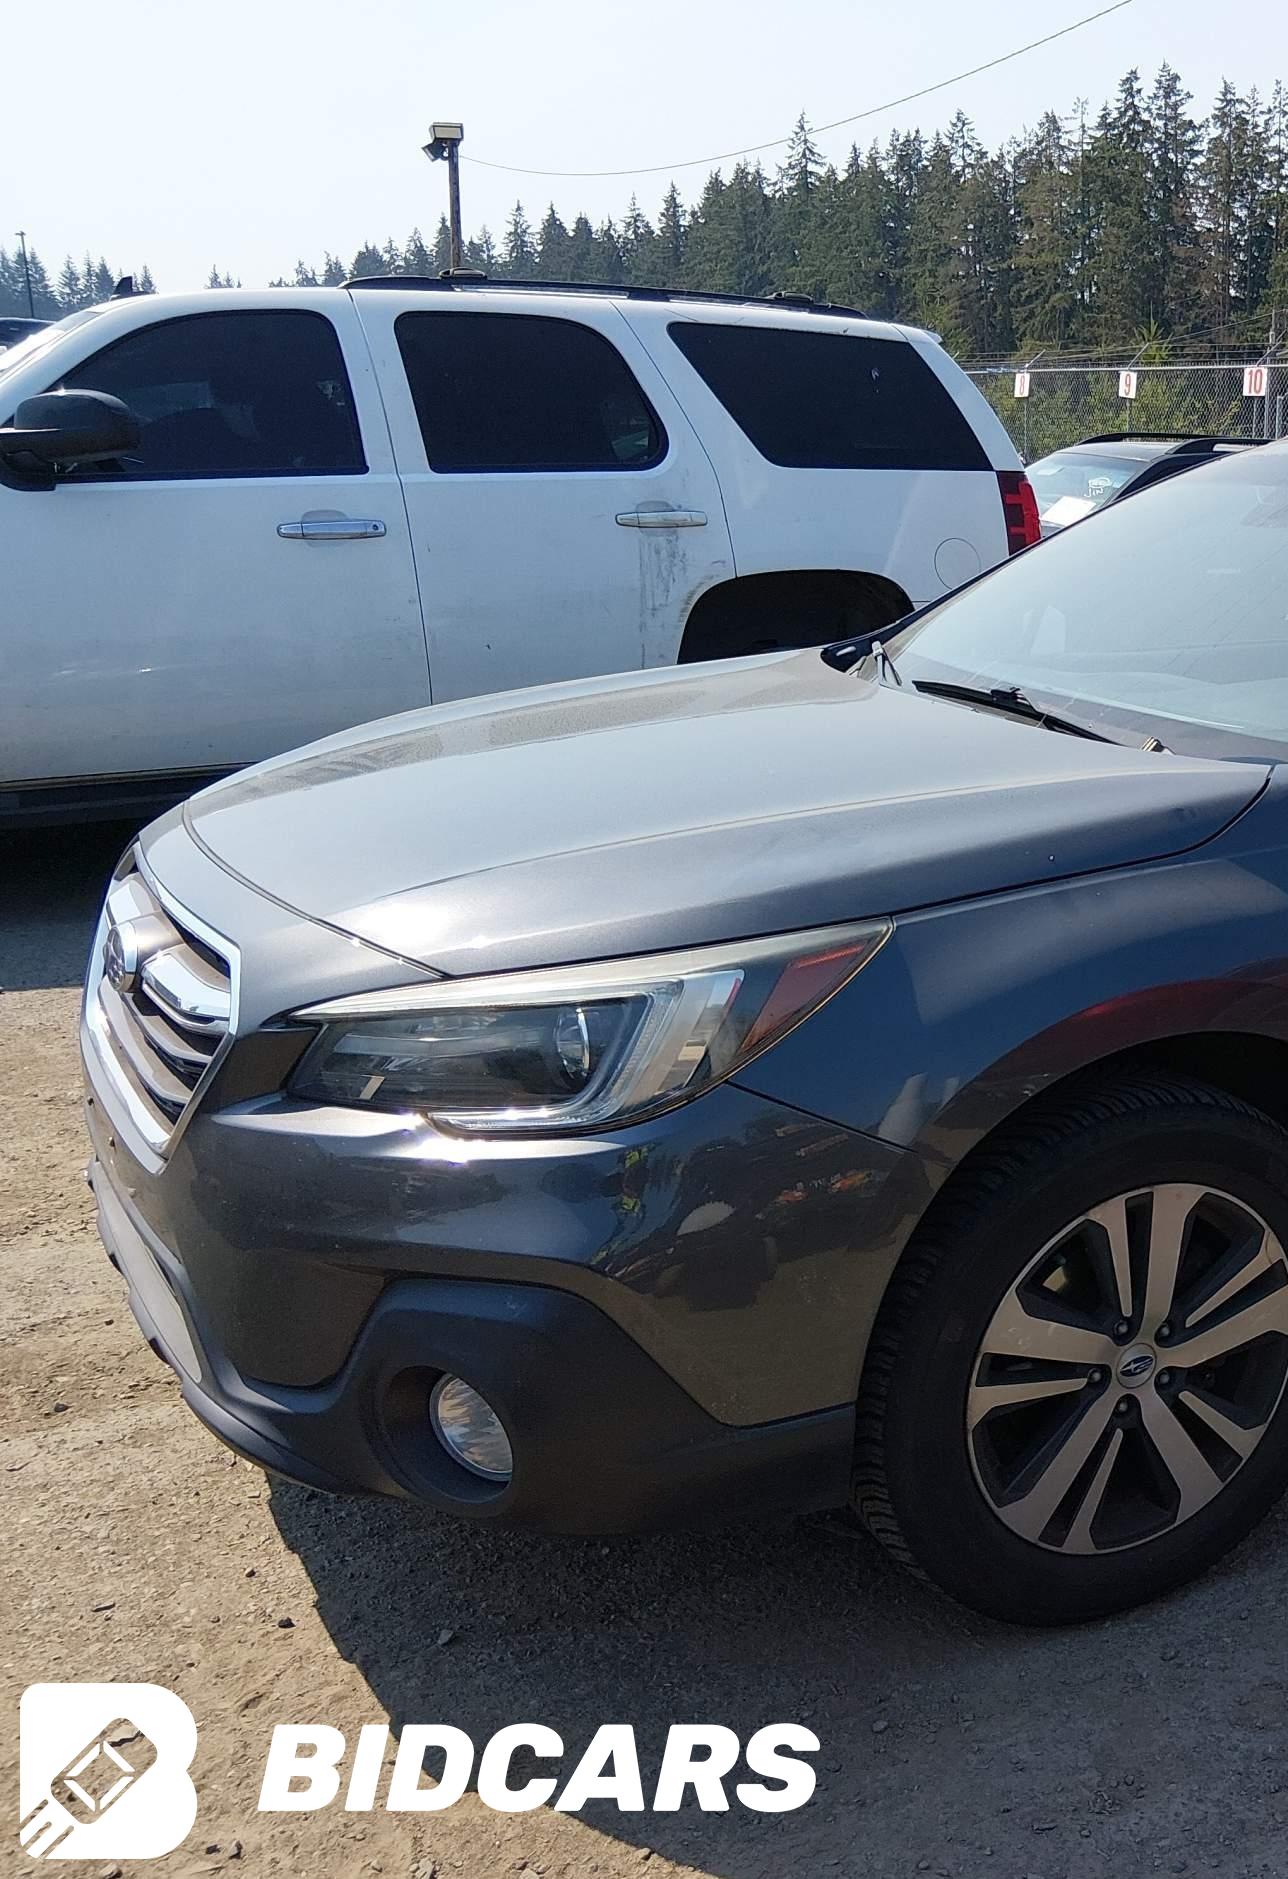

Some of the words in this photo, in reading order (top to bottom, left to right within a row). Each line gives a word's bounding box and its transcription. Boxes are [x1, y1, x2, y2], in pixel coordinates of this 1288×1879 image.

[1019, 375, 1026, 396] 8
[1124, 373, 1132, 396] 9
[1247, 369, 1263, 394] 10
